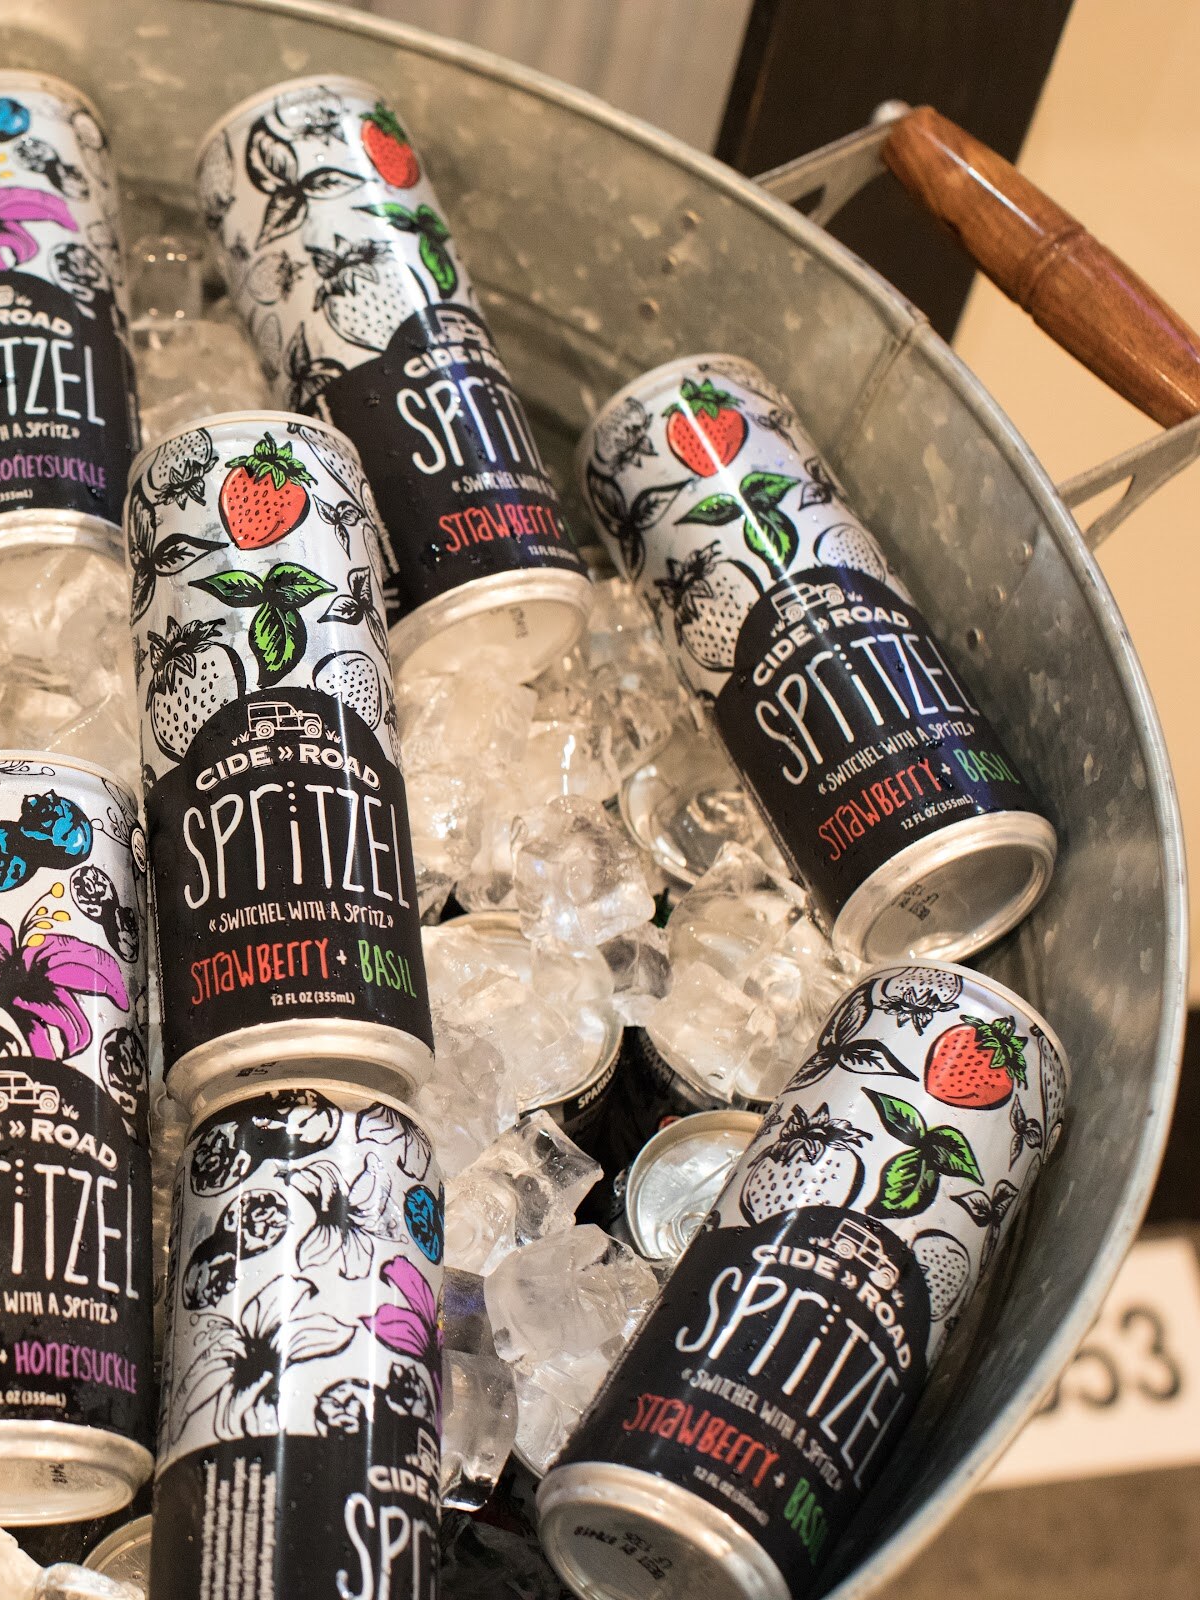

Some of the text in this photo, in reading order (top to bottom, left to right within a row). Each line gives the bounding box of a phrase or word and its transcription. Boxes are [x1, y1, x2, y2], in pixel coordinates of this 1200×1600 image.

[404, 346, 470, 378] CIDE
[13, 422, 23, 439] A
[753, 606, 910, 687] CIDE ROAD
[195, 743, 381, 791] CIDE ROAD
[827, 744, 883, 792] SWITCHEL
[880, 726, 917, 757] WITH
[919, 726, 929, 742] A
[953, 748, 1020, 784] BASIL
[900, 818, 914, 831] 12
[913, 812, 923, 825] FL
[924, 805, 938, 819] OZ
[219, 902, 284, 934] SWITCHEL
[288, 900, 330, 921] WITH
[330, 900, 340, 921] A
[358, 939, 417, 998] BASIL
[270, 993, 284, 1006] 12
[285, 992, 298, 1005] FL
[299, 992, 314, 1004] OZ
[30, 1118, 118, 1171] ROAD
[4, 1291, 43, 1316] WITH
[48, 1292, 59, 1316] A
[752, 1244, 912, 1369] CIDE ROAD
[1013, 1305, 1182, 1418] 53
[6, 1390, 21, 1404] OZ
[759, 1400, 796, 1441] WITH
[792, 1428, 807, 1449] A
[367, 1465, 430, 1502] CIDE
